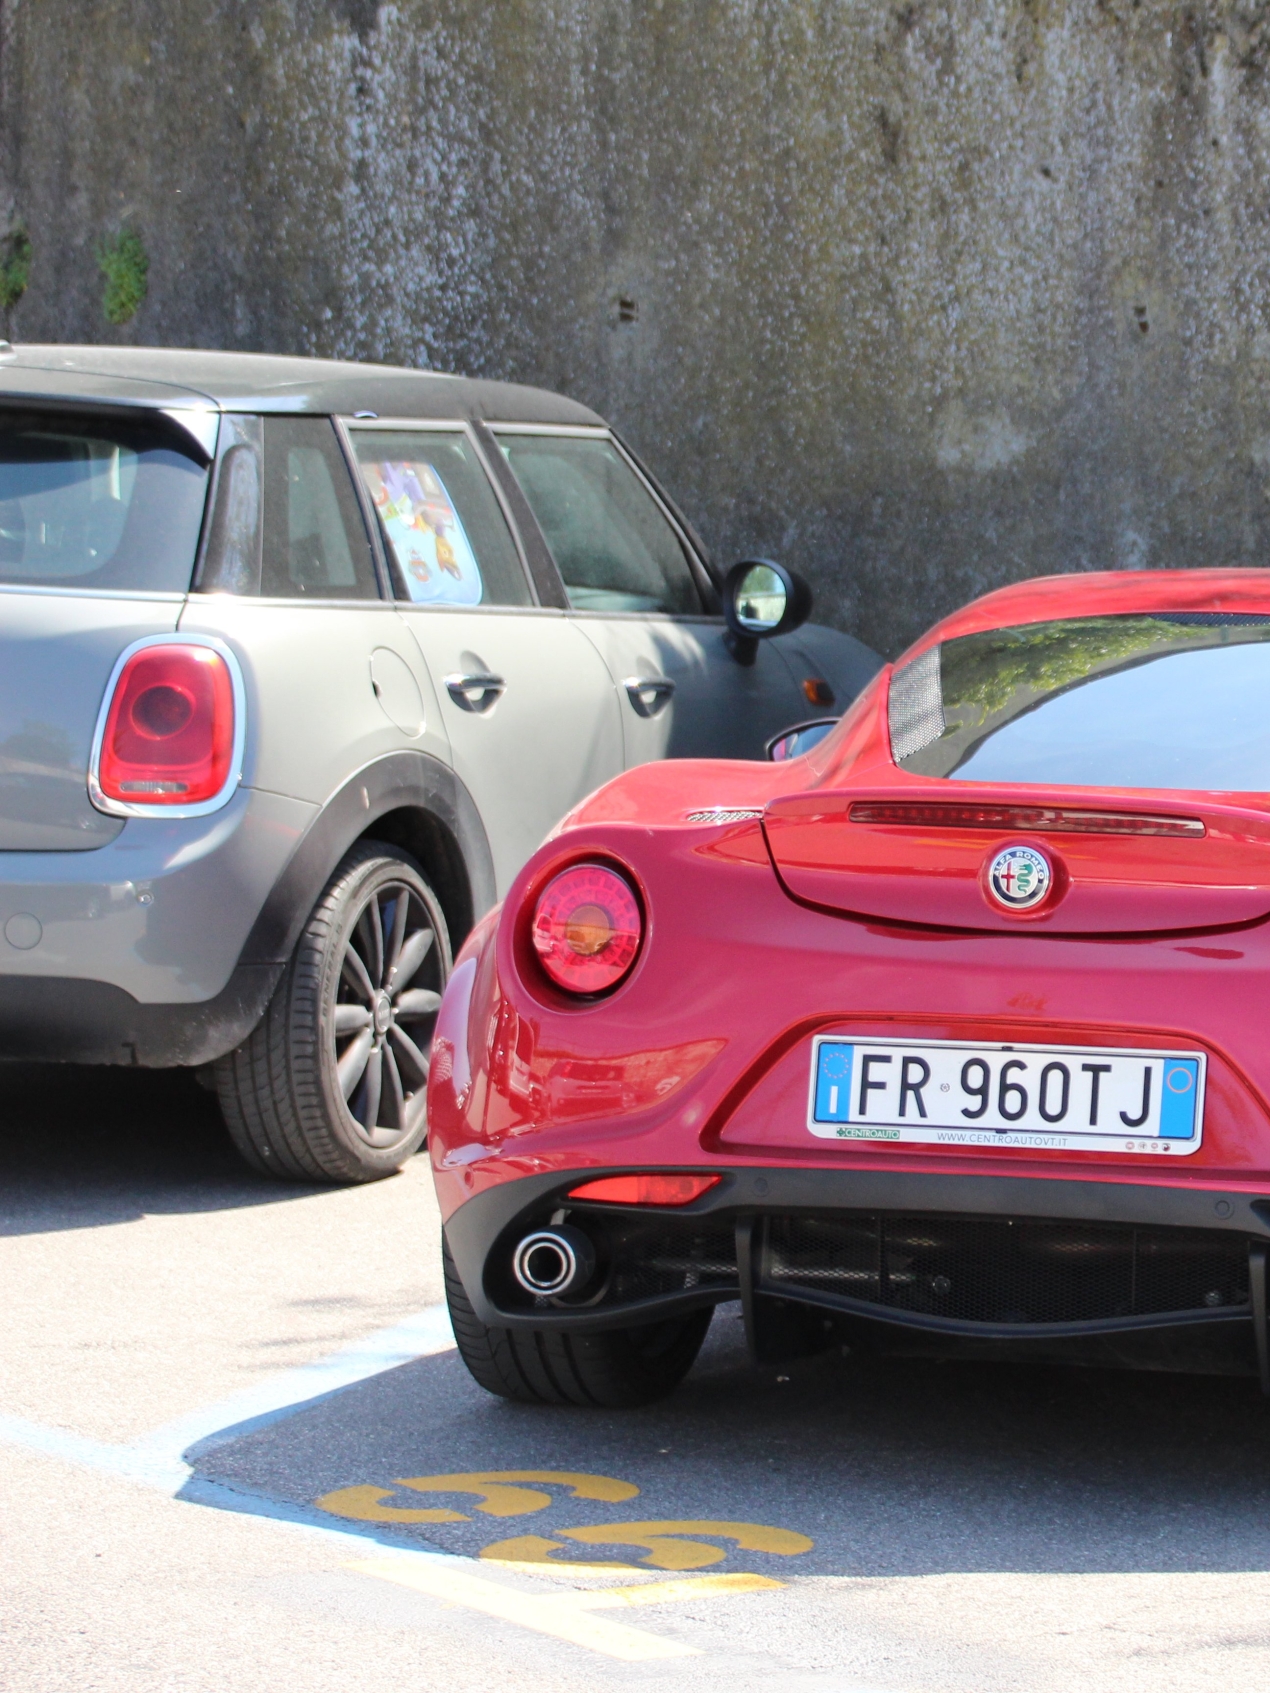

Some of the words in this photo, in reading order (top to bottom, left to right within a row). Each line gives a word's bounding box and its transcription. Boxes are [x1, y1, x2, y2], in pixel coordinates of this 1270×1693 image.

[992, 854, 1013, 877] ALFA
[1016, 851, 1044, 880] ROMEO
[858, 1054, 931, 1118] FR
[959, 1057, 1153, 1127] 960TJ
[845, 1128, 900, 1139] CENTROAUTO
[937, 1132, 1069, 1147] WWW.CENTROAUTOVT.IT
